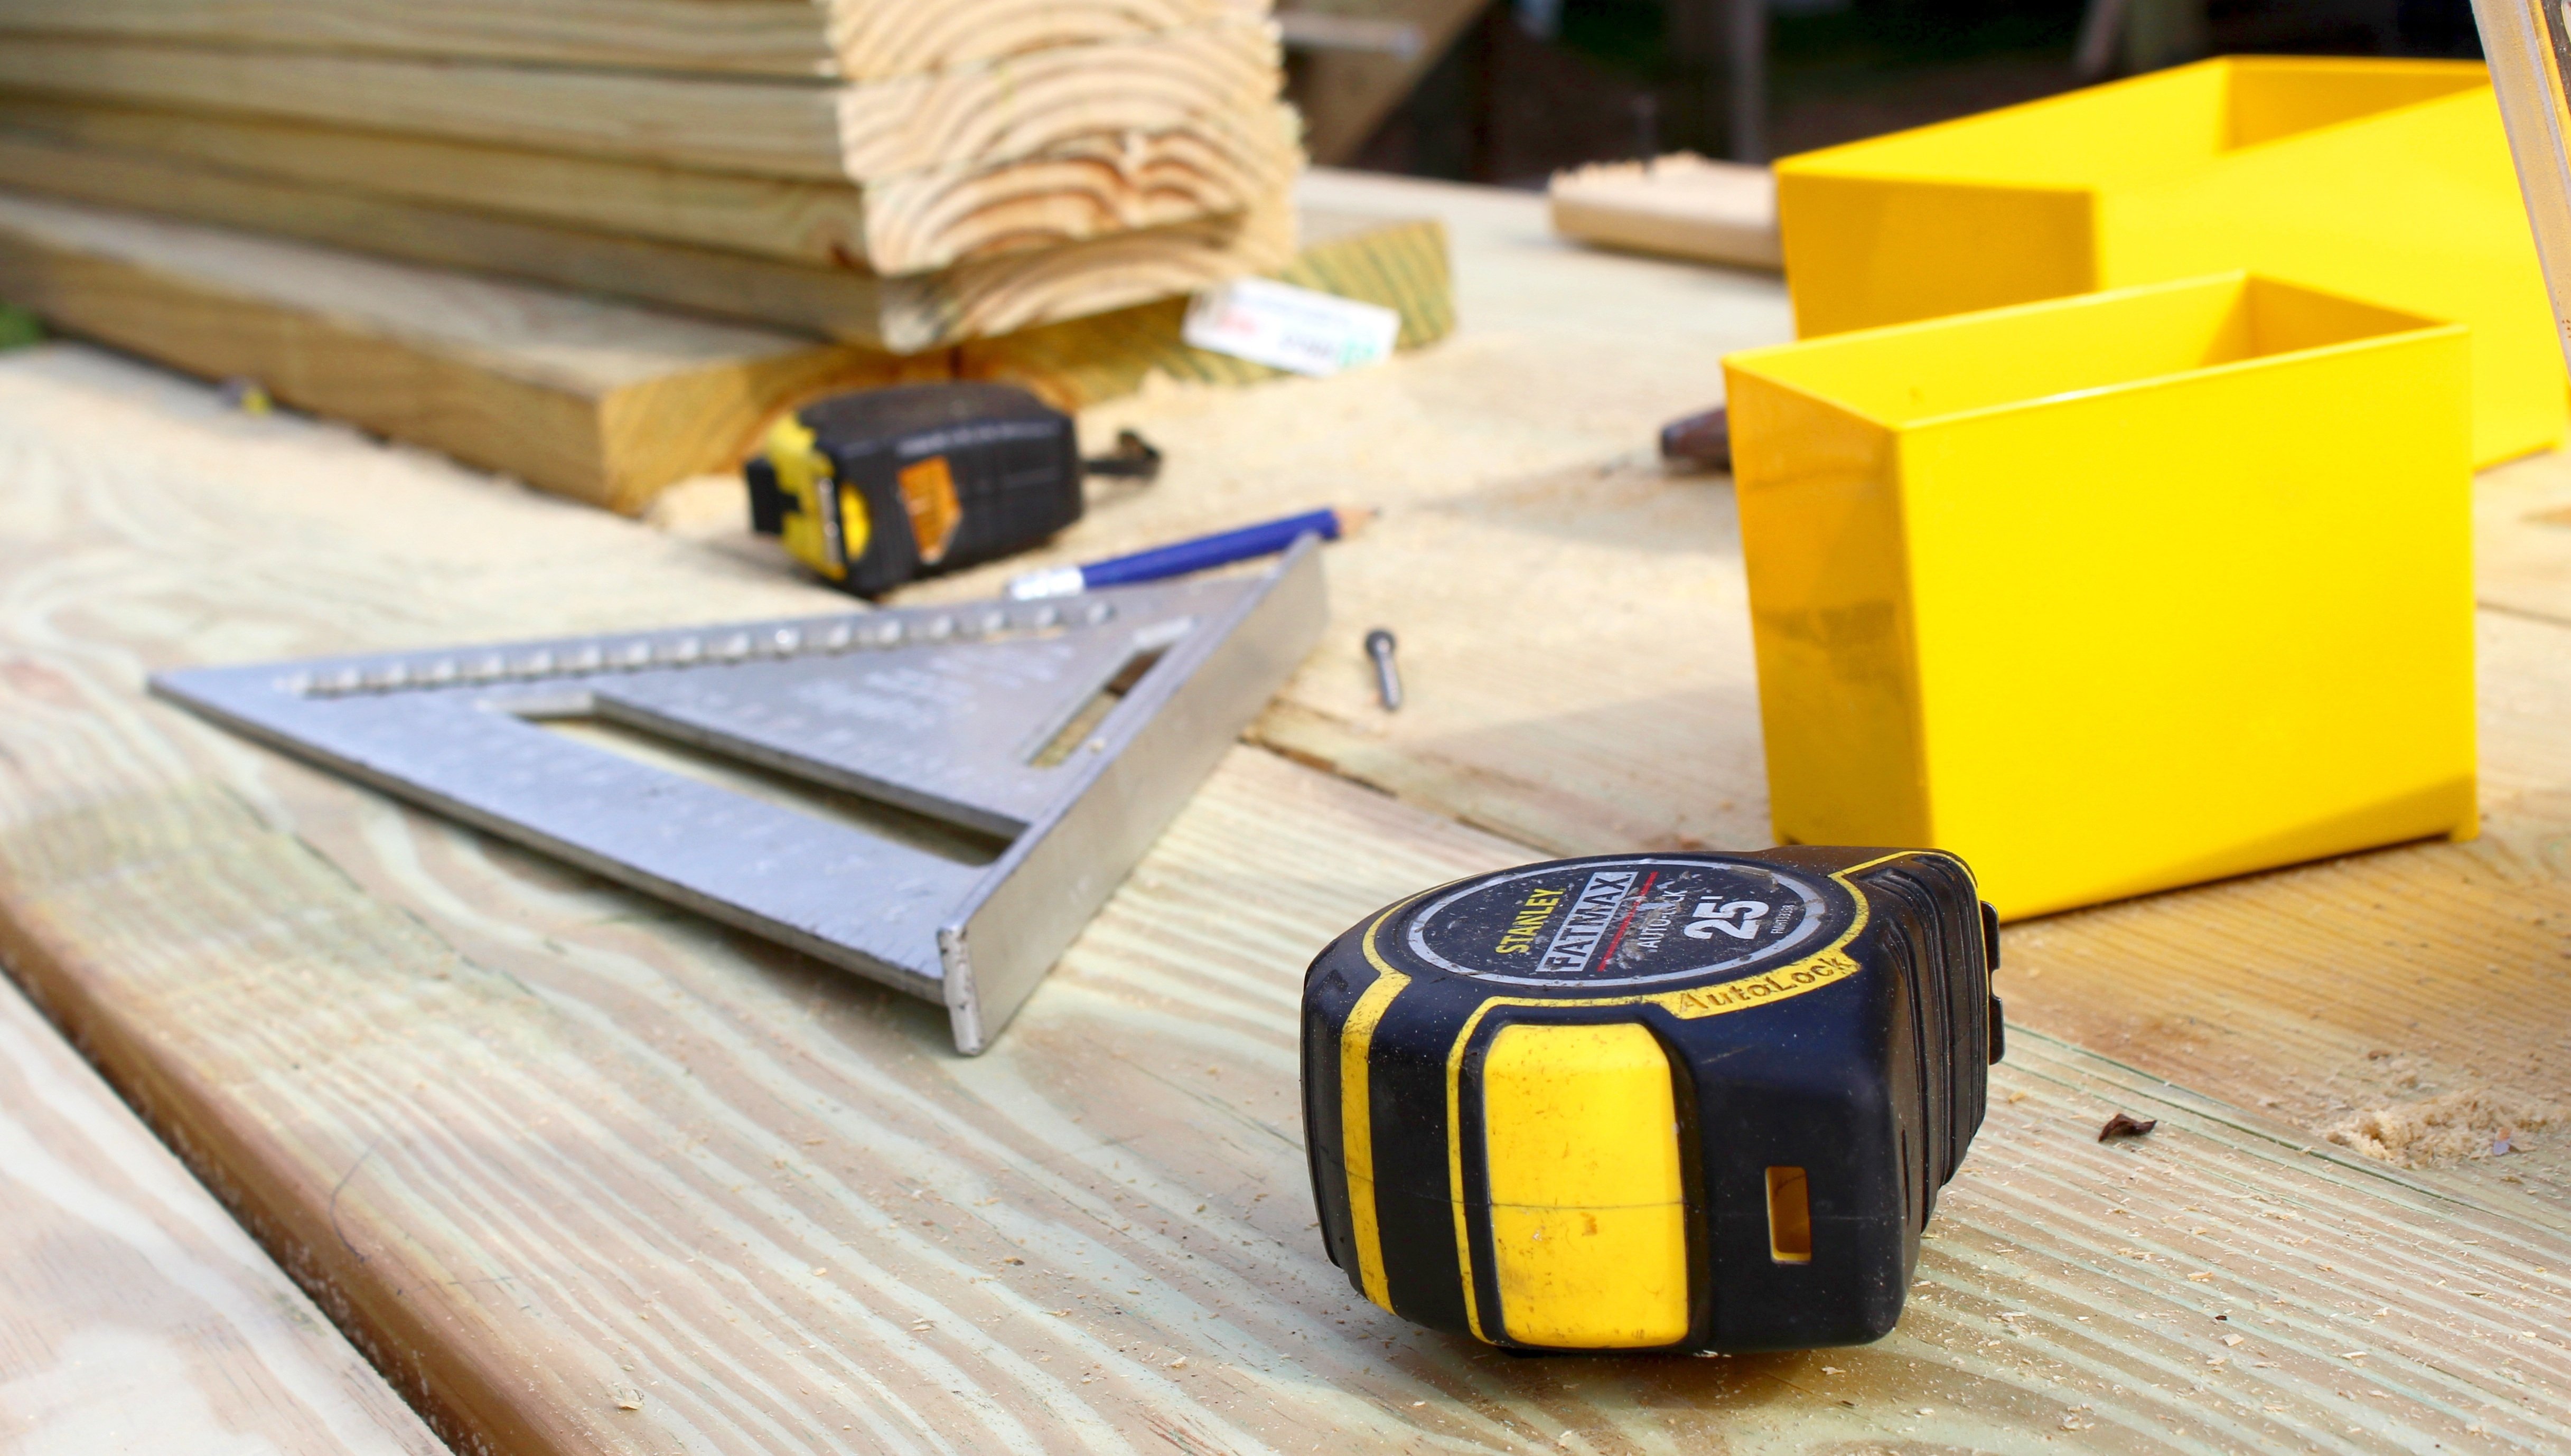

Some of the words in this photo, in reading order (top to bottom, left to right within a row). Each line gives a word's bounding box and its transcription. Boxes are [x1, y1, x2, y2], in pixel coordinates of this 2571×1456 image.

[1495, 888, 1564, 954] STANLEY
[1542, 877, 1632, 967] FATMAX
[1678, 957, 1852, 1013] AutoLock
